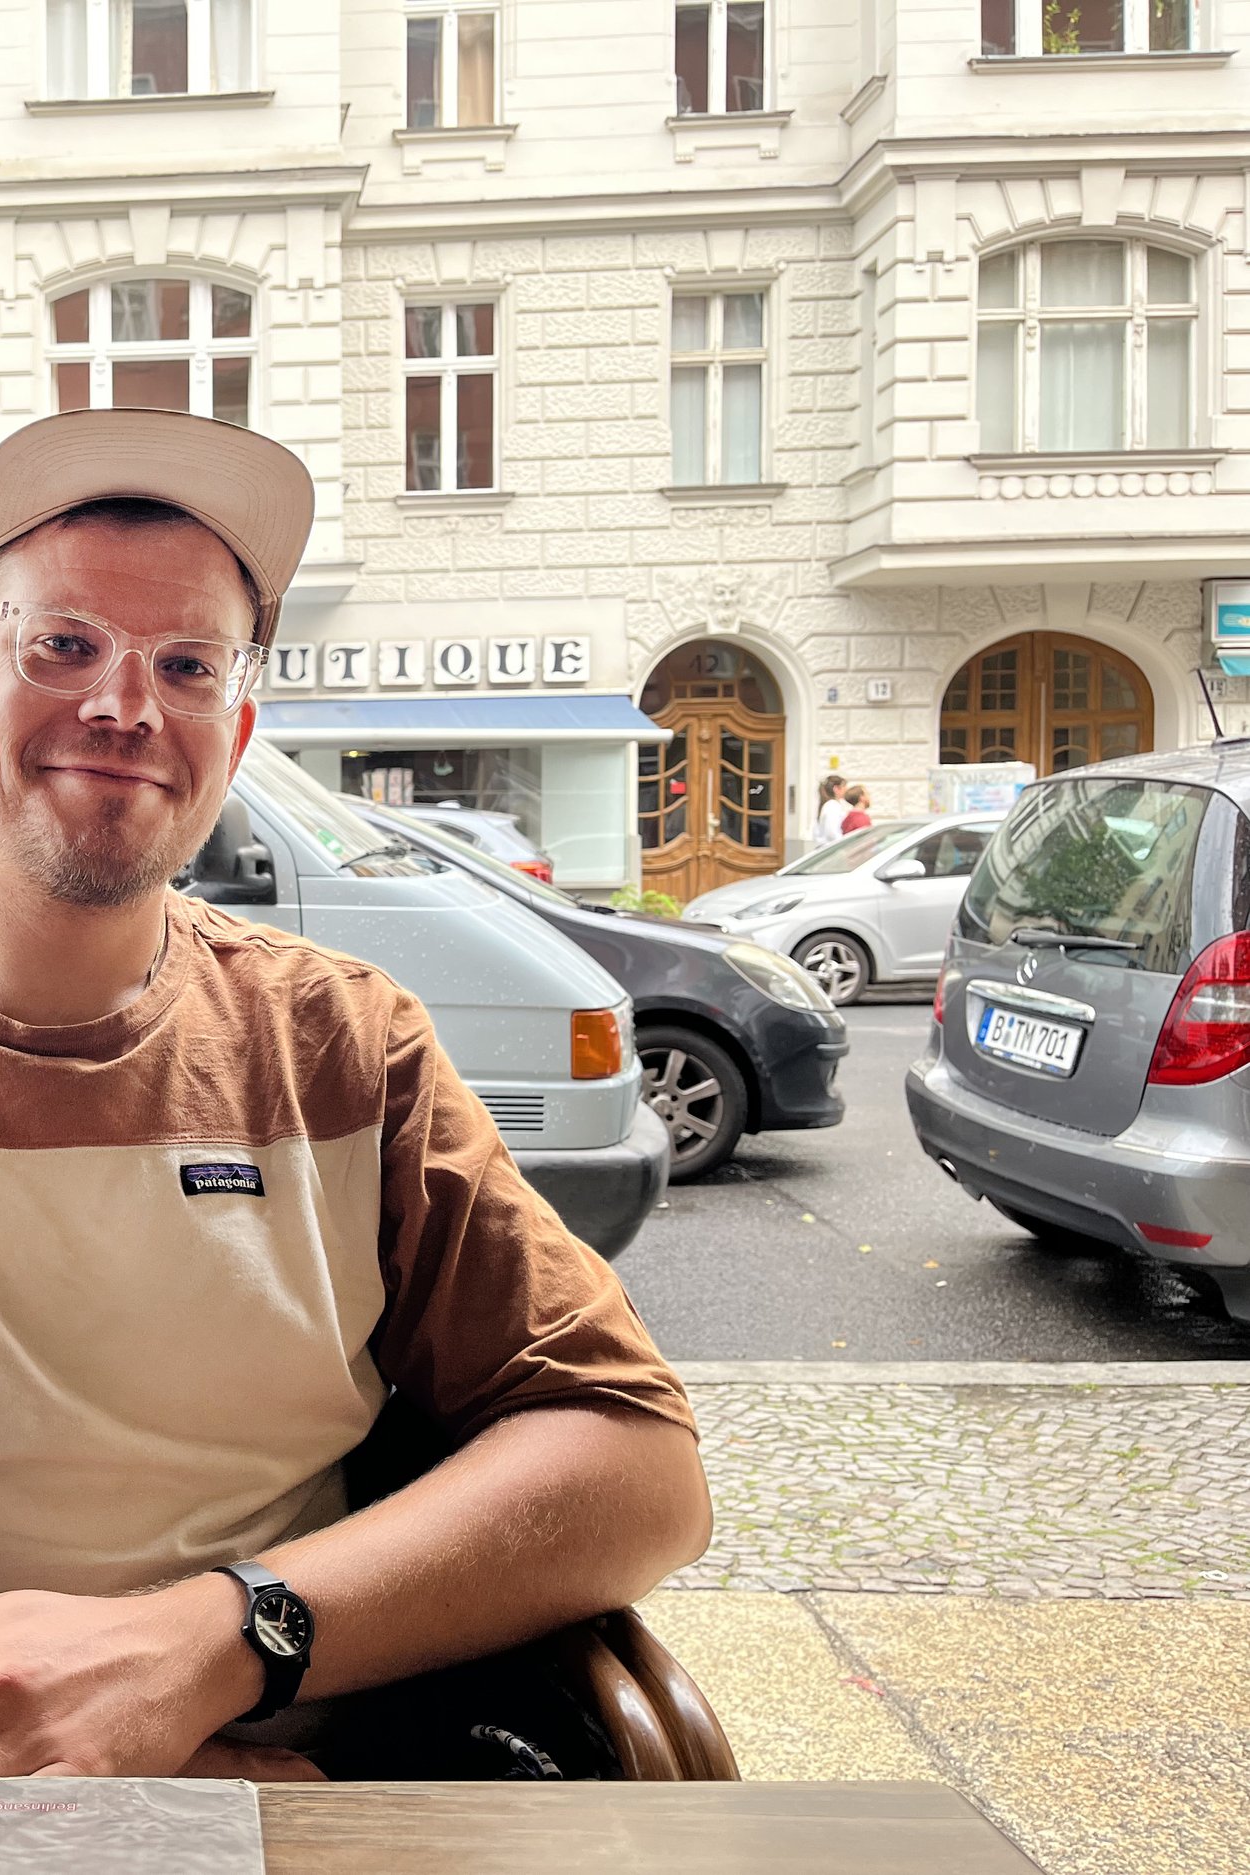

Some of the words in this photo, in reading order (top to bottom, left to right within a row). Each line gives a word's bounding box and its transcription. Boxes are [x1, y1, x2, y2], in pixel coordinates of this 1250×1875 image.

[276, 640, 583, 681] UTIQUE
[874, 682, 888, 697] 12
[992, 1015, 1005, 1041] B
[1013, 1020, 1037, 1053] TM
[1036, 1026, 1069, 1061] 701
[195, 1177, 256, 1189] patagonia
